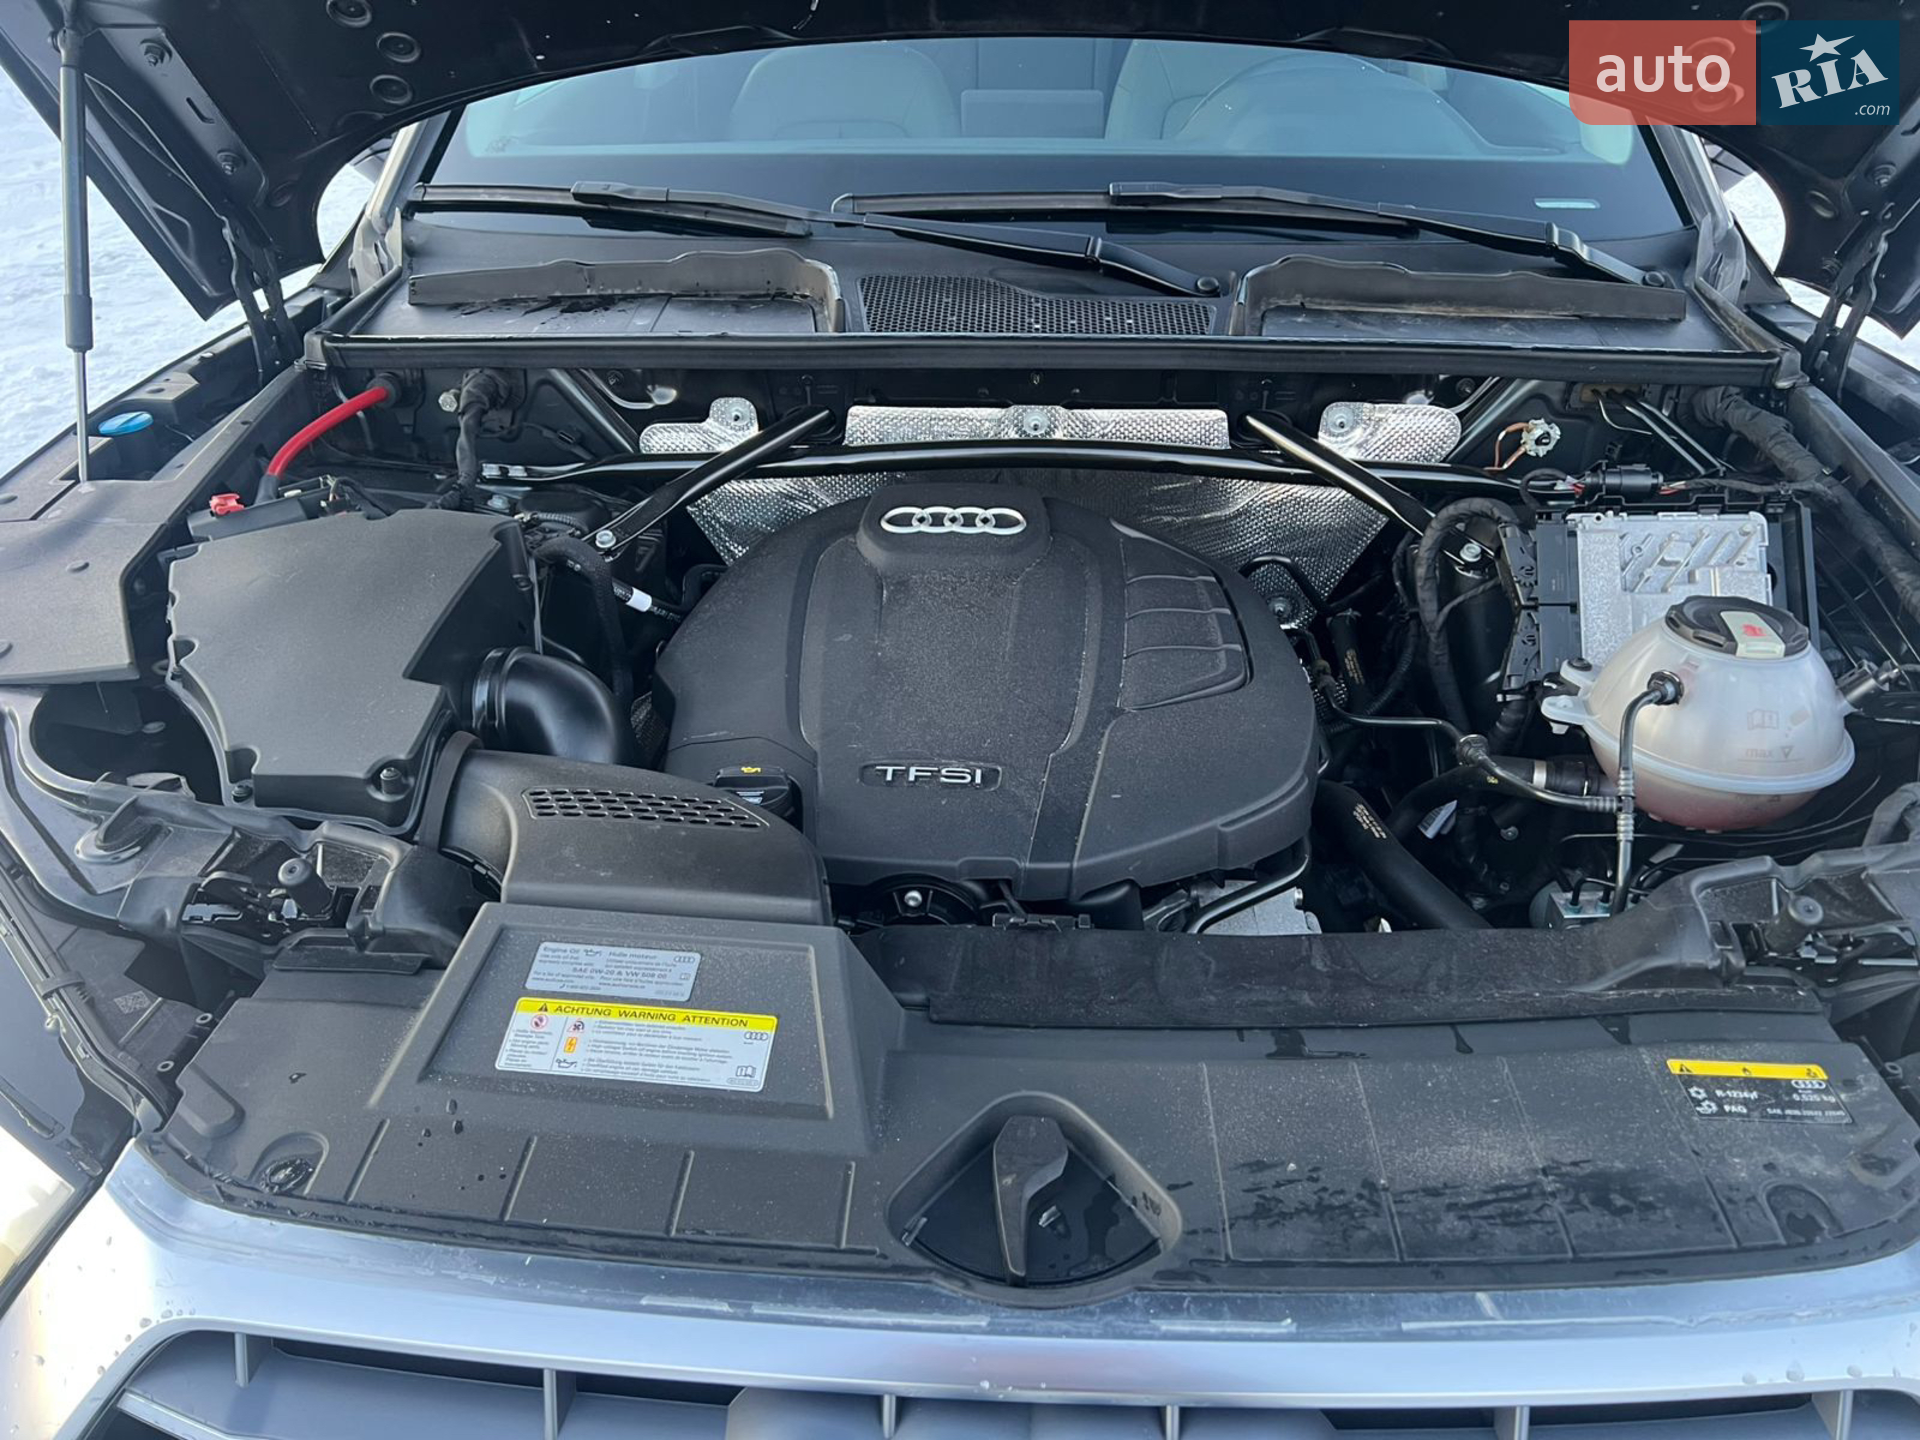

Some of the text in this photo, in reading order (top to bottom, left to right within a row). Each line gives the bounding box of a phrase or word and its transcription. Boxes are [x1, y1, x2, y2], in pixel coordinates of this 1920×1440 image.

[875, 765, 982, 784] TFSI
[554, 1004, 612, 1017] ACHTUNG
[618, 1009, 677, 1022] WARNING
[682, 1013, 749, 1028] ATTENTION
